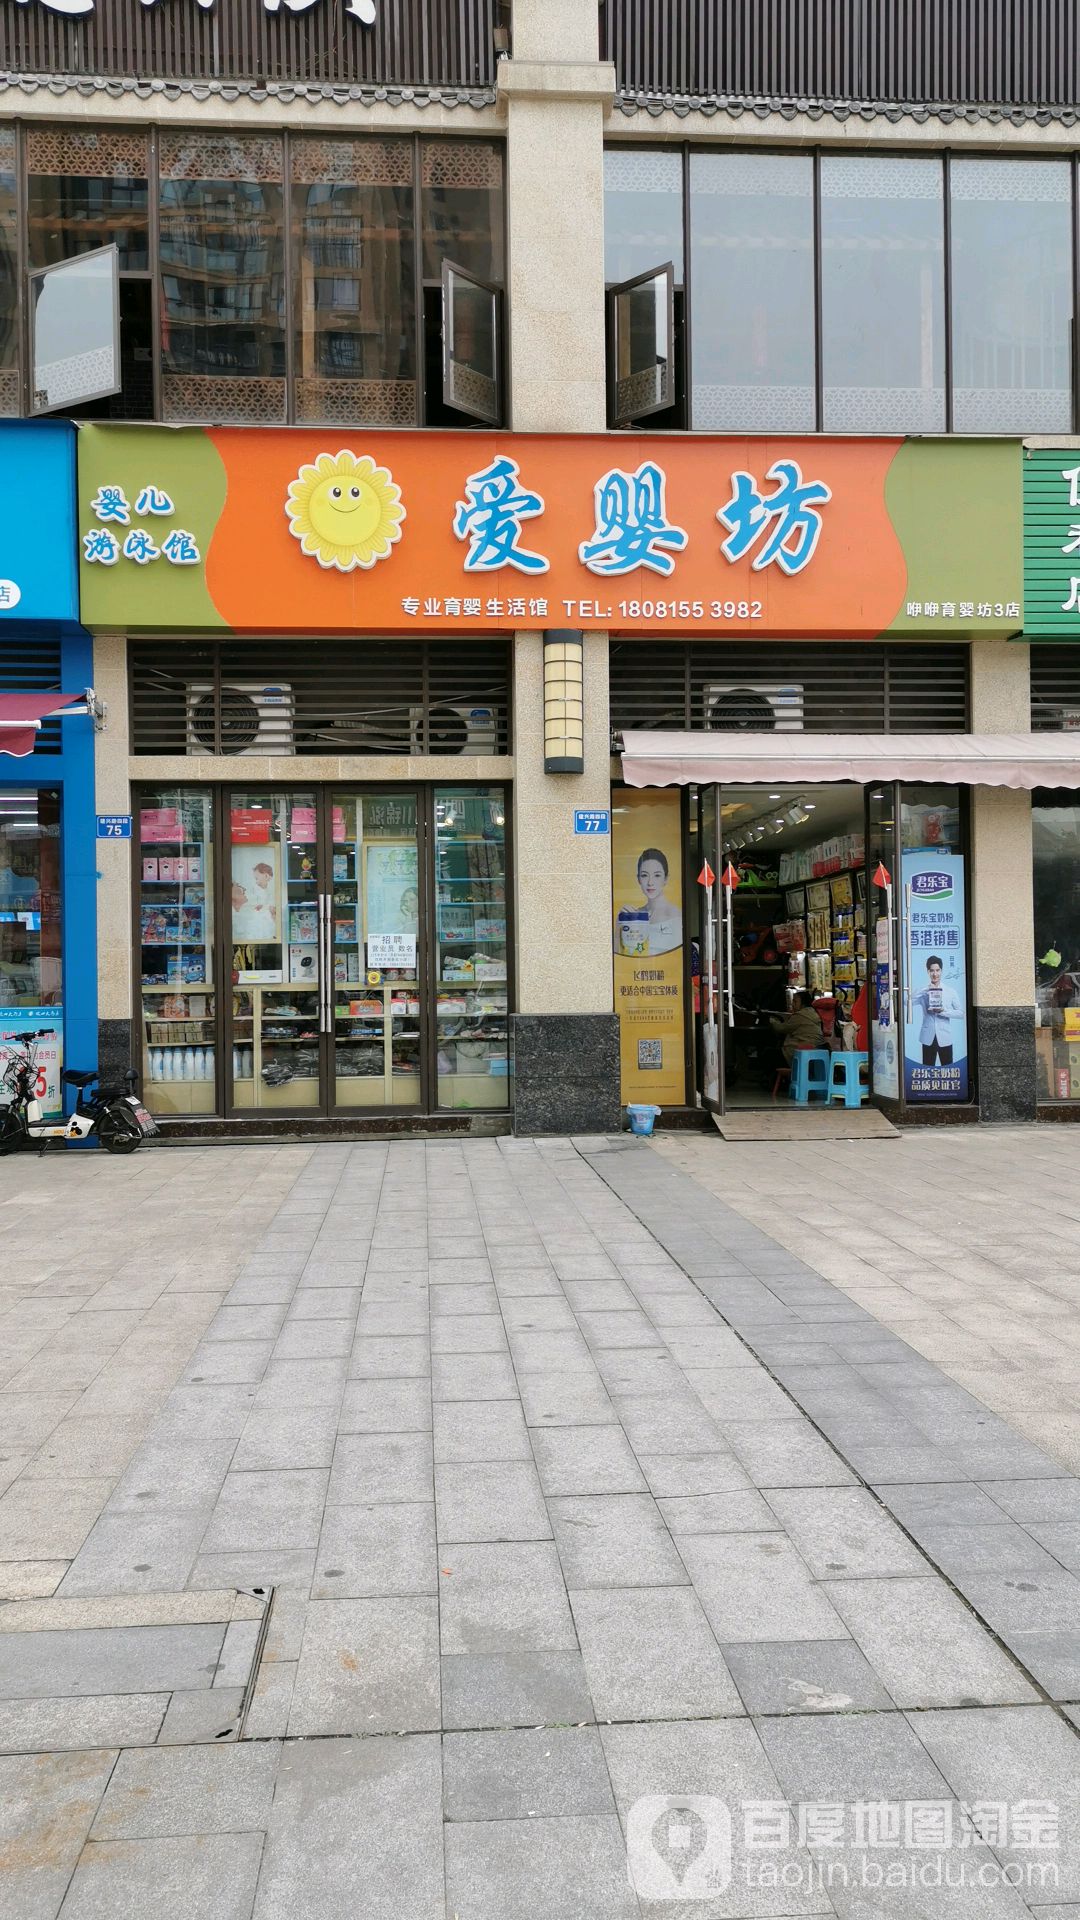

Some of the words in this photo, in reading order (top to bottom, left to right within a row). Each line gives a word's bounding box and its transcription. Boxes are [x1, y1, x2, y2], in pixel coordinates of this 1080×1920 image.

[90, 486, 175, 526] 婴儿
[453, 455, 832, 577] 爱婴坊
[83, 528, 201, 566] 游泳馆
[401, 597, 549, 617] 专业育婴生活馆
[562, 600, 612, 618] TEL:
[618, 600, 704, 618] 1808155
[710, 600, 763, 618] 3982
[106, 825, 122, 836] 75
[585, 821, 600, 831] 77
[917, 876, 949, 888] 君乐宝
[912, 913, 954, 923] 君乐宝奶粉
[382, 935, 403, 945] 招聘
[911, 1068, 961, 1078] 君乐宝奶粉
[911, 1080, 961, 1090] 品质见证官
